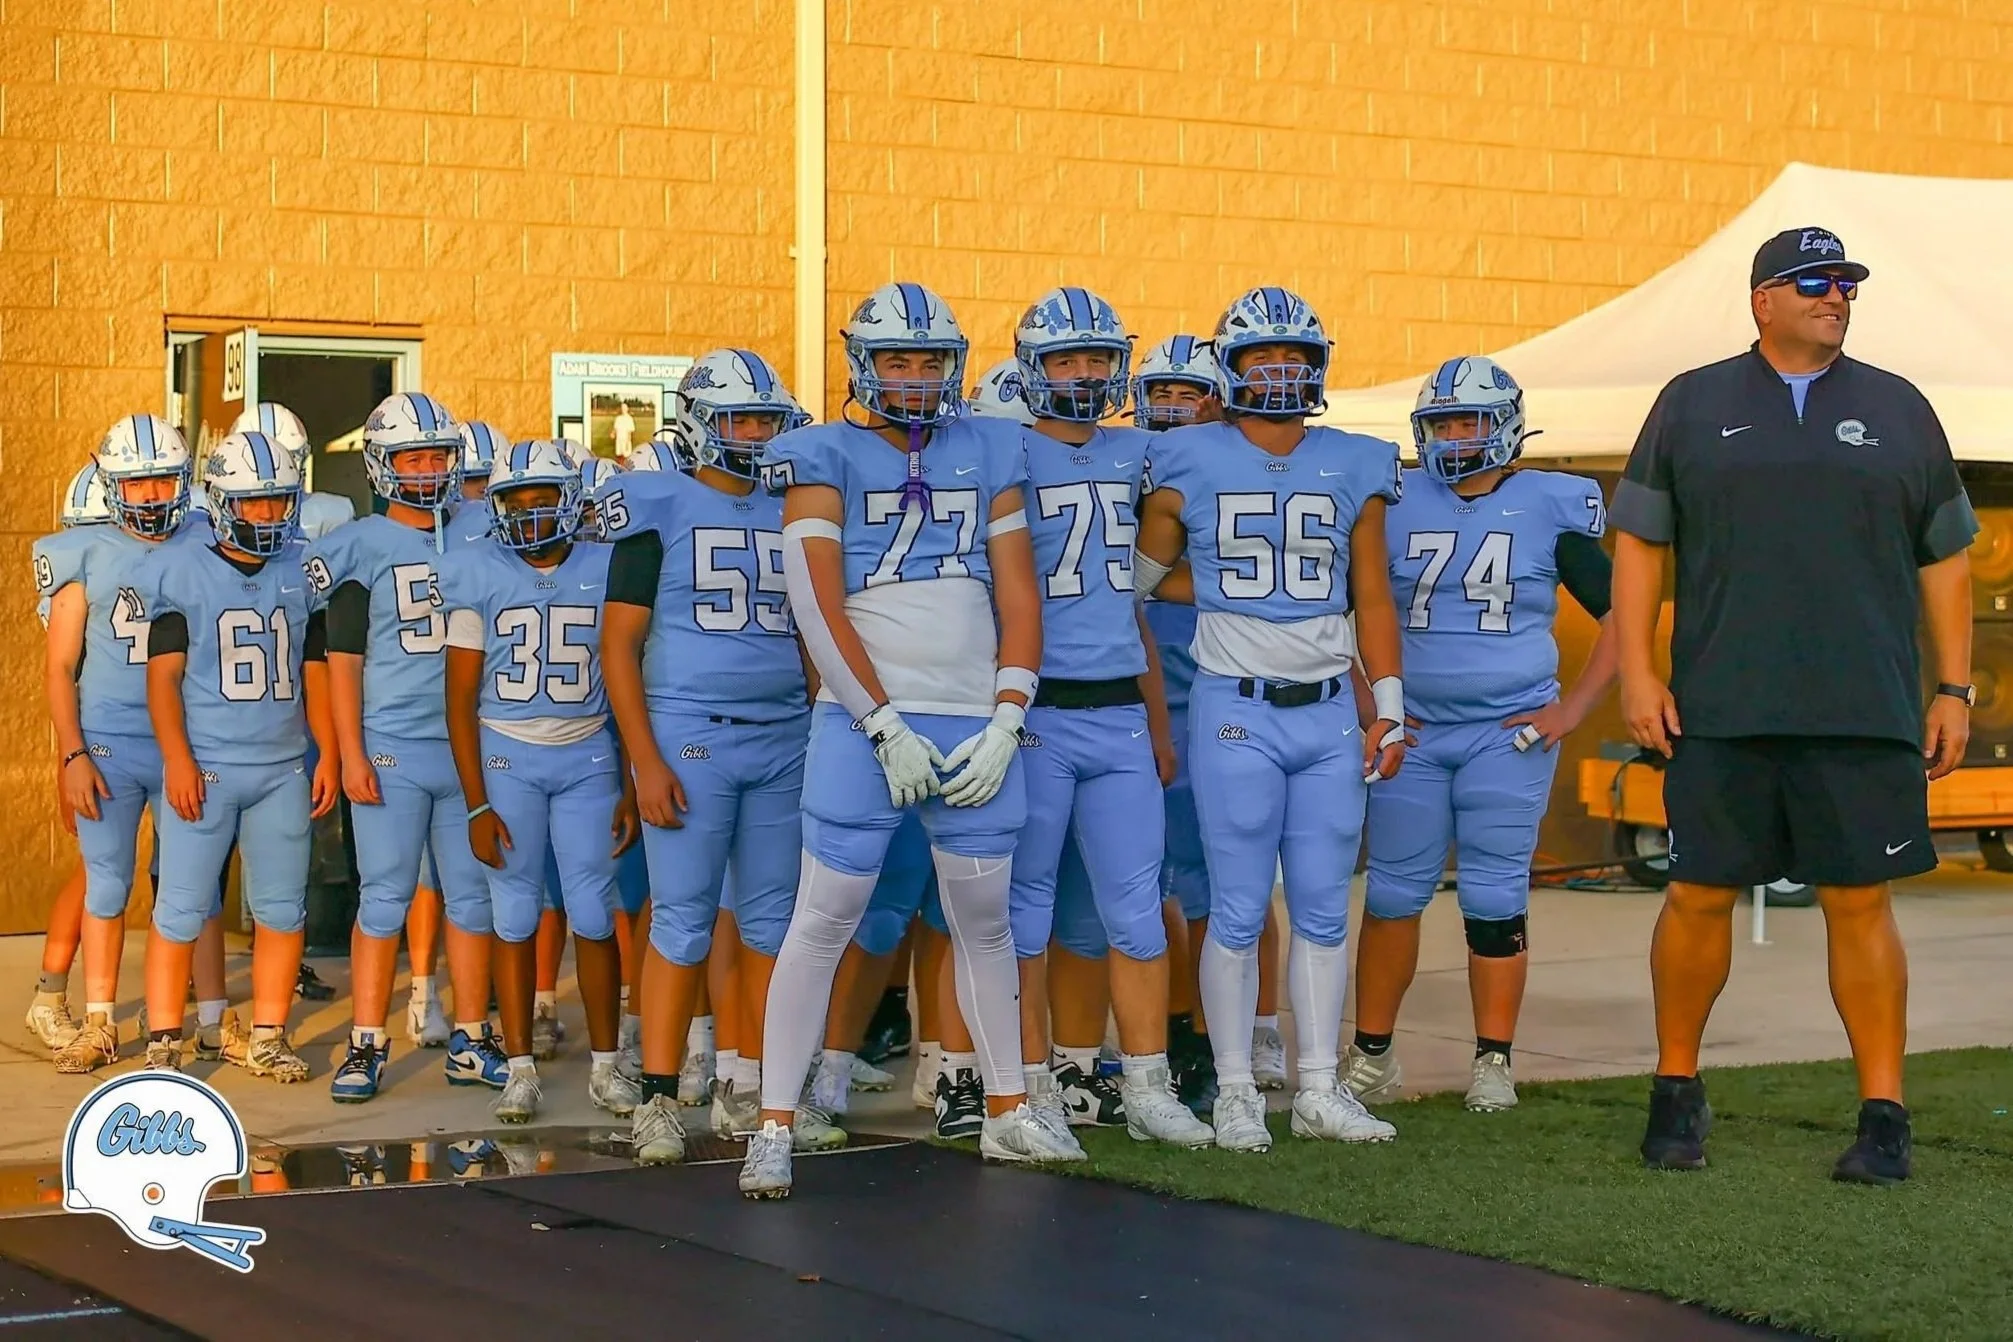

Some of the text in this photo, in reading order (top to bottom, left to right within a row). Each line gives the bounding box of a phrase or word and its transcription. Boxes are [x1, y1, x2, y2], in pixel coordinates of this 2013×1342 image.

[228, 341, 242, 393] 98
[864, 488, 979, 589] 77
[1036, 480, 1138, 600] 75
[1216, 491, 1338, 601] 56
[1585, 496, 1606, 534] 7
[110, 587, 151, 665] 4
[392, 562, 447, 655] 5
[428, 573, 444, 607] 5
[692, 527, 792, 634] 55
[1405, 531, 1515, 634] 74
[217, 606, 295, 702] 61
[494, 605, 598, 703] 35
[680, 744, 711, 760] Gibbs
[1018, 733, 1043, 748] ibbs
[1217, 723, 1249, 741] Gibbs
